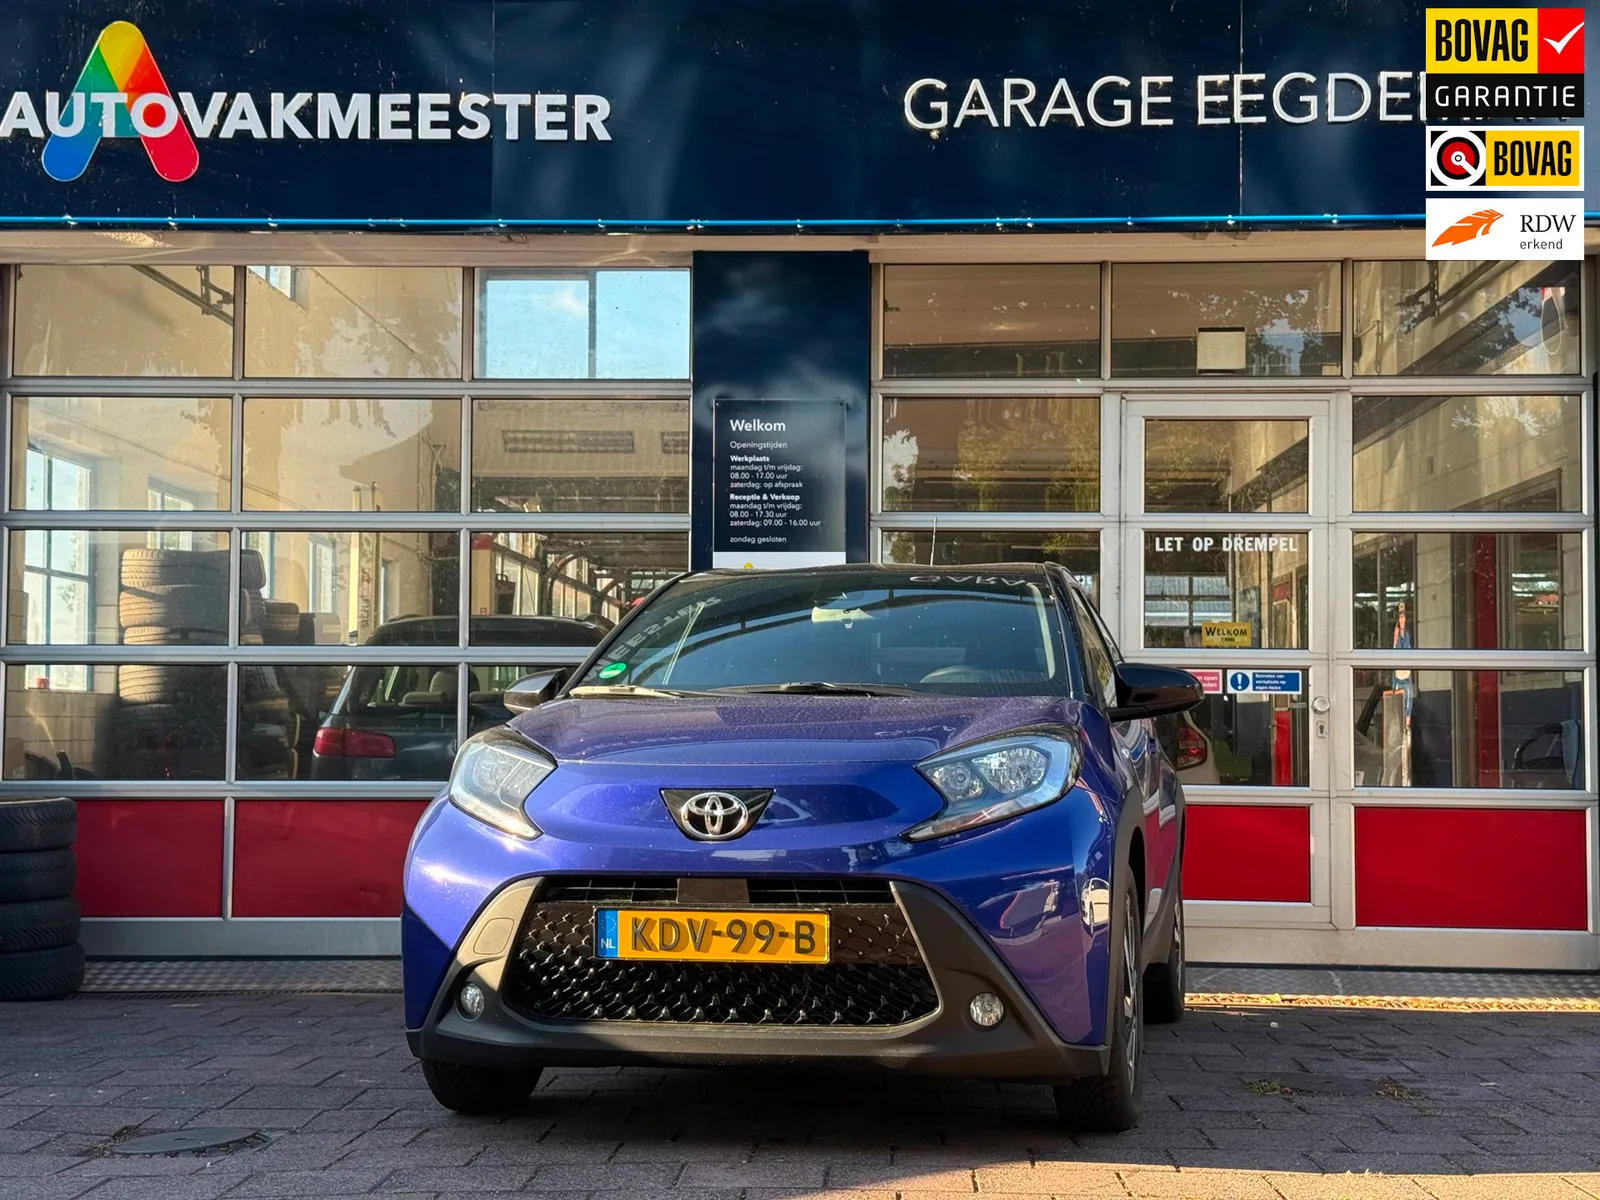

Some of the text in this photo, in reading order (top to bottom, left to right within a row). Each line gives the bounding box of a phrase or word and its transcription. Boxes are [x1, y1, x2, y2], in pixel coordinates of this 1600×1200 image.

[904, 71, 1427, 129] GARAGE EEGDE
[0, 91, 612, 141] AUTOVAKMEESTER
[730, 419, 786, 432] Welkom
[730, 441, 788, 450] Openingstijden
[730, 455, 770, 463] Werkplaats
[730, 464, 762, 472] maandag
[777, 464, 803, 472] vrijdag:
[730, 481, 762, 489] zaterdag:
[774, 481, 803, 489] afspraak
[729, 493, 761, 502] Receptie
[770, 493, 801, 502] Verkoop
[729, 502, 762, 510] maandag
[776, 502, 803, 511] vrijdag:
[730, 519, 762, 527] zaterdag:
[730, 536, 787, 544] zondag gesloten
[1155, 537, 1298, 552] LET OP DREMPEL
[1205, 626, 1248, 637] WELKOM
[631, 917, 816, 954] KDV-99-B
[600, 938, 616, 949] NL
